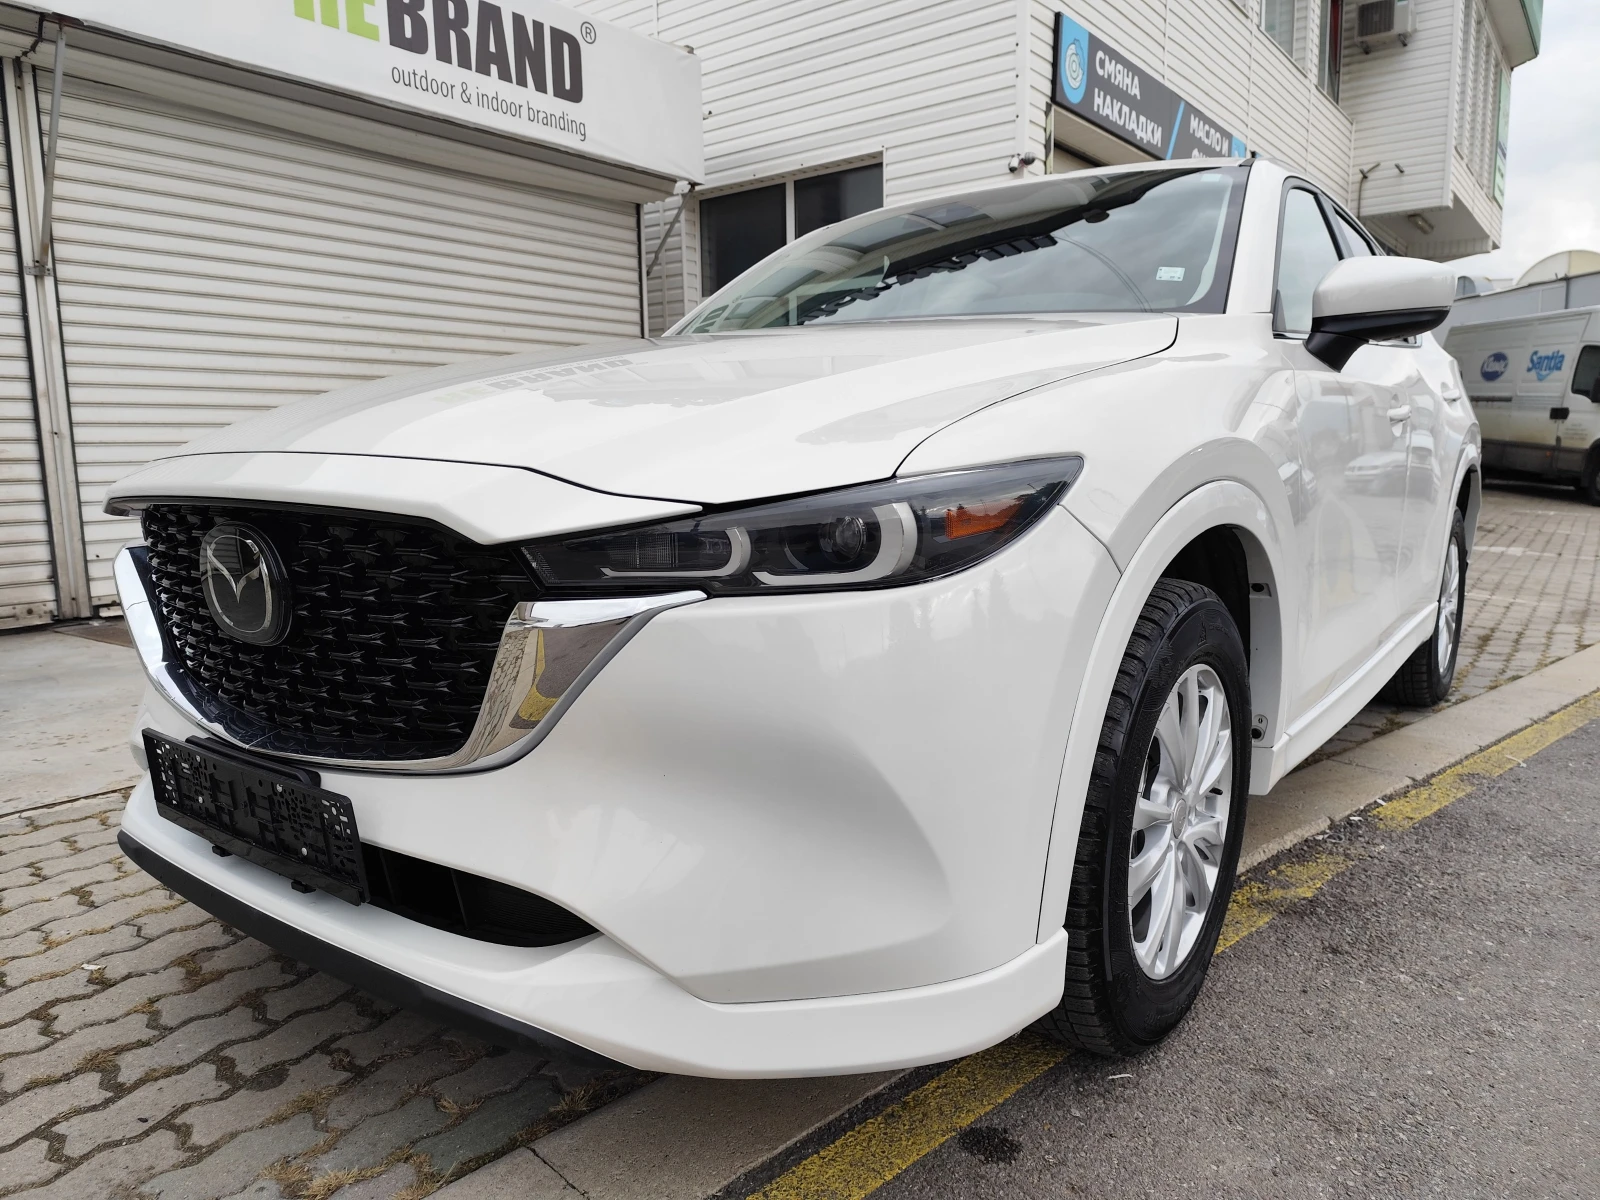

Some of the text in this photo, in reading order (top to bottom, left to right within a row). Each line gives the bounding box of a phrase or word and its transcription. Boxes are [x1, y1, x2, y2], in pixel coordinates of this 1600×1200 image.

[1096, 50, 1140, 100] СМЯНА
[391, 66, 587, 142] outdoor & indoor branding
[1093, 87, 1162, 148] НАКЛАДКИ
[1189, 113, 1229, 157] МАСЛО И
